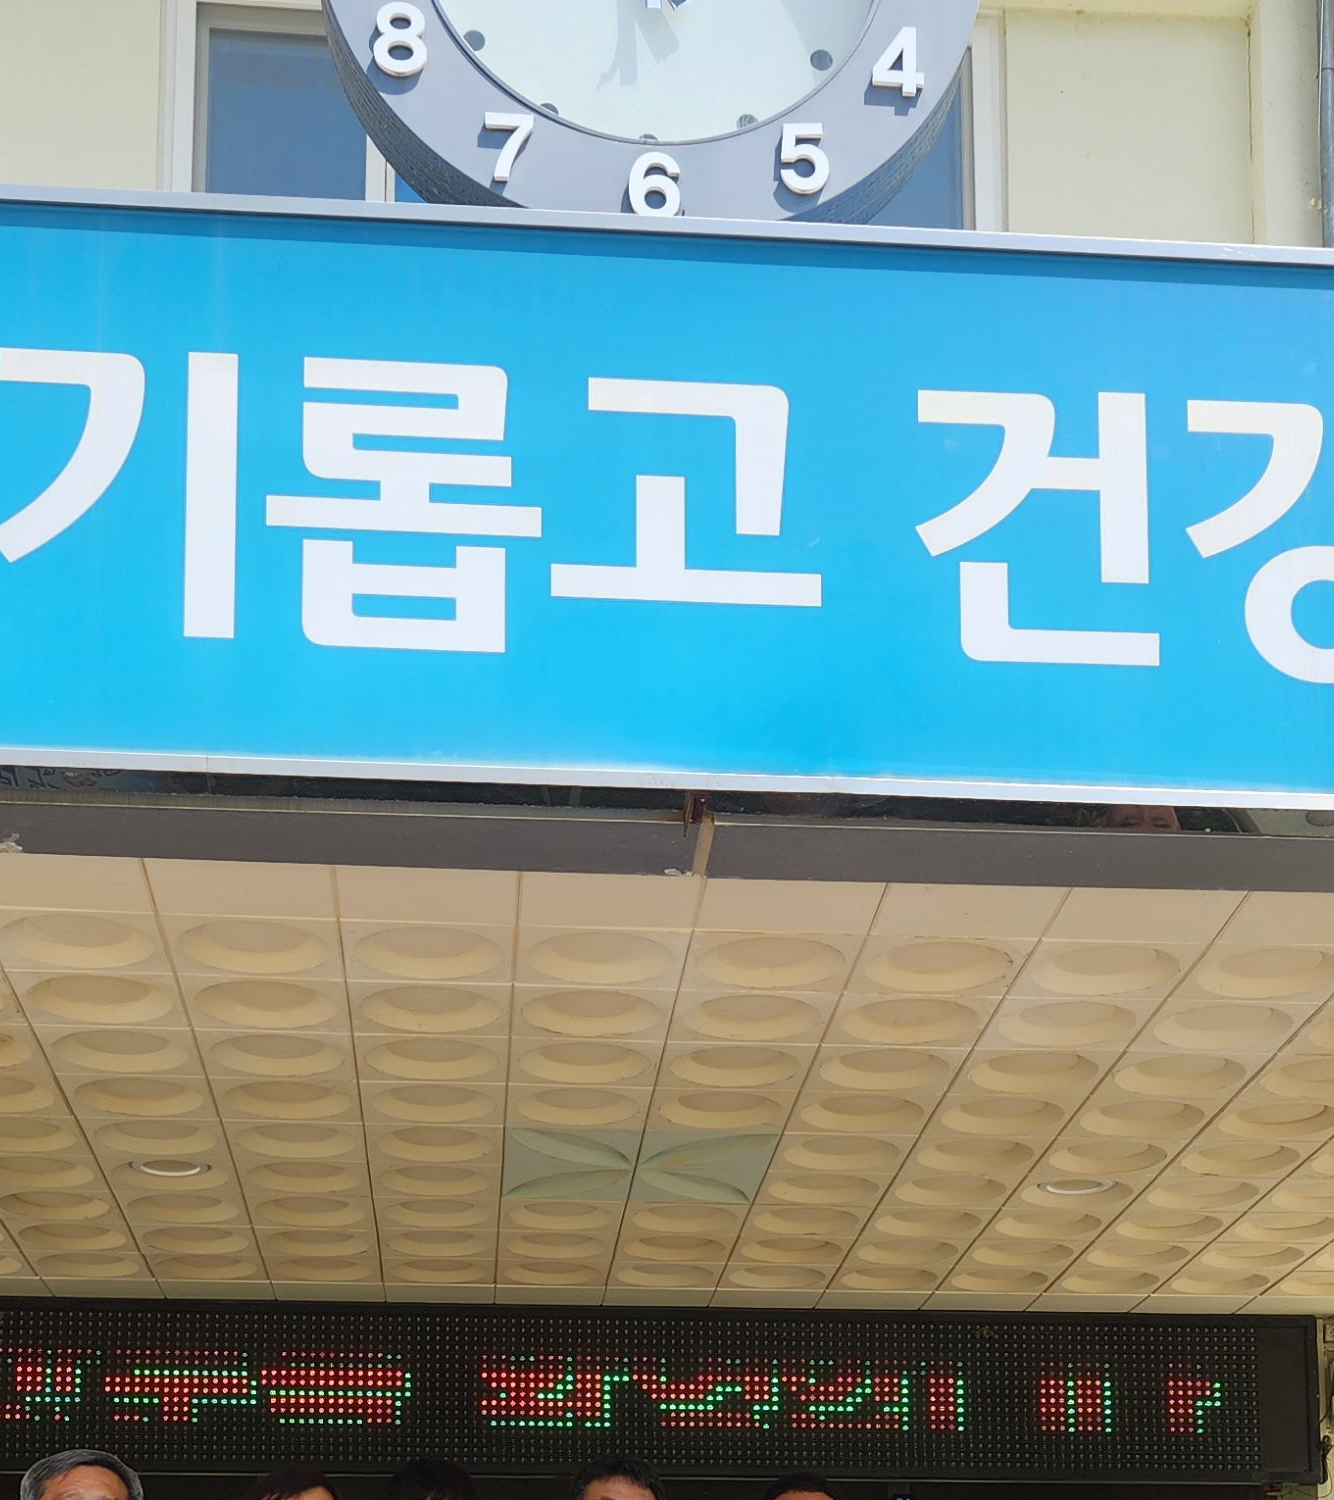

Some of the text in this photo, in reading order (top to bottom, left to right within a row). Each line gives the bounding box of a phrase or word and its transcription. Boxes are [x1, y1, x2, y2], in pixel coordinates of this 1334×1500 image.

[373, 1, 427, 77] 8
[873, 27, 924, 97] 4
[485, 112, 534, 182] 7
[780, 123, 829, 194] 5
[629, 151, 681, 217] 6
